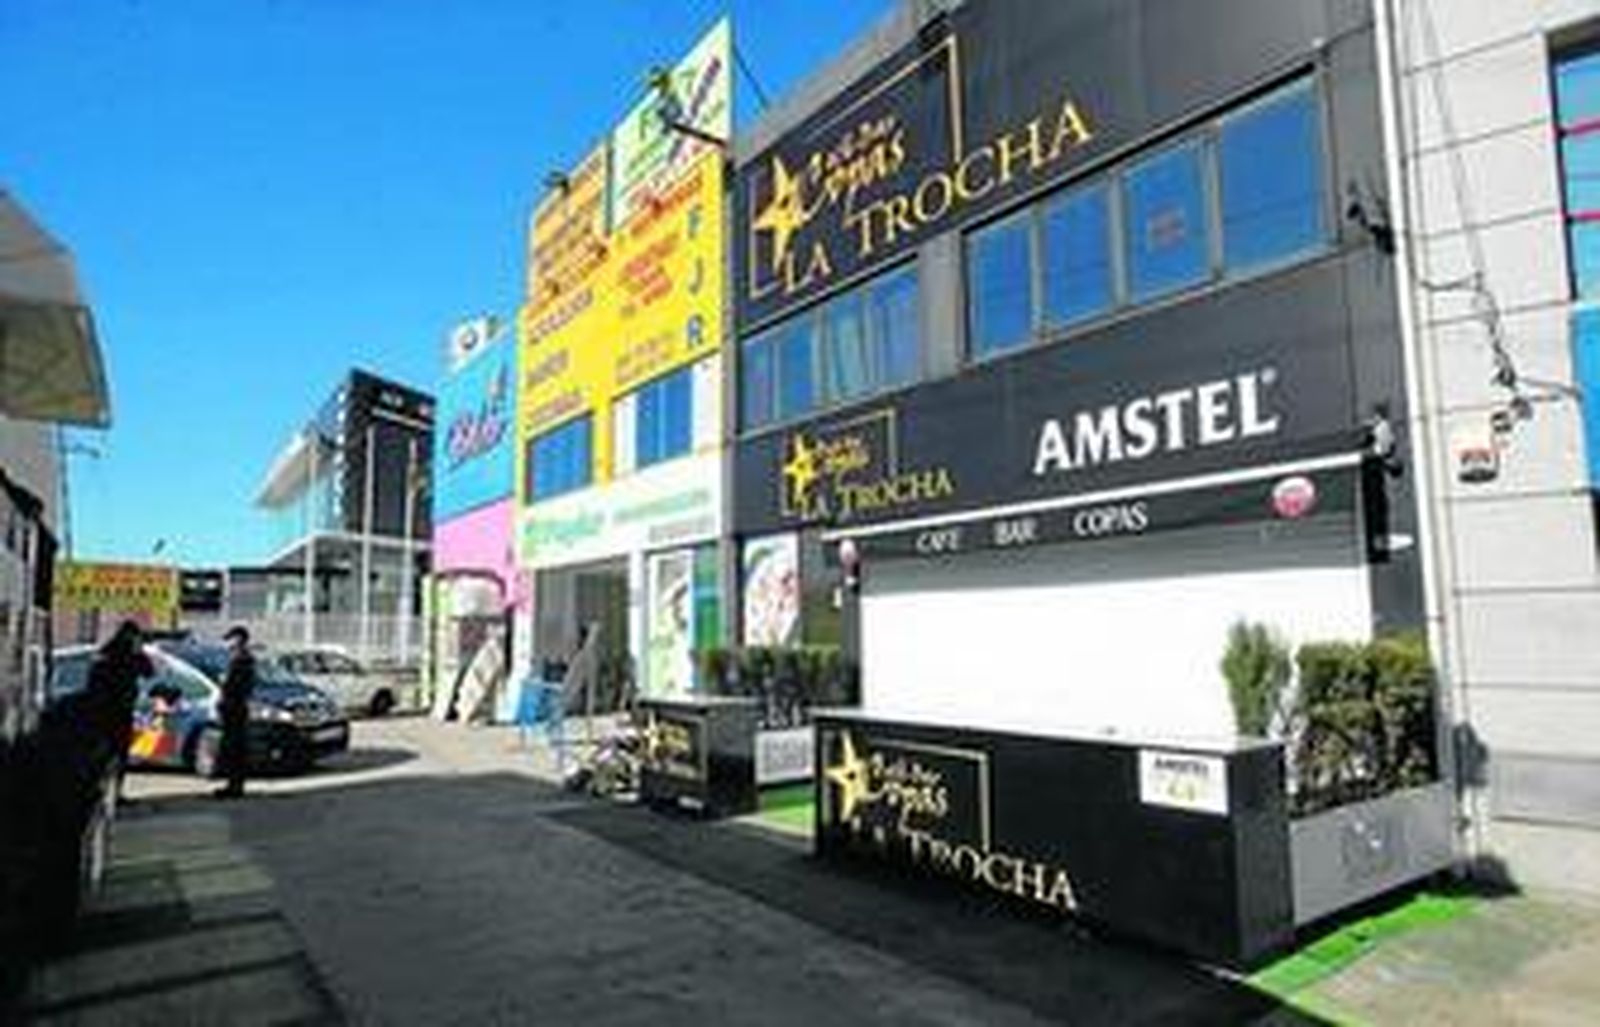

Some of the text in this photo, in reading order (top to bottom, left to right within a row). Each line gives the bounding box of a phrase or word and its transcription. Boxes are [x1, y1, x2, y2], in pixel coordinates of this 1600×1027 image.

[784, 241, 832, 294] LA
[843, 100, 1092, 256] TROCHA
[1033, 373, 1278, 474] AMSTEL
[836, 467, 953, 522] TROCHA
[994, 518, 1037, 545] BAR
[1074, 501, 1149, 536] COPAS
